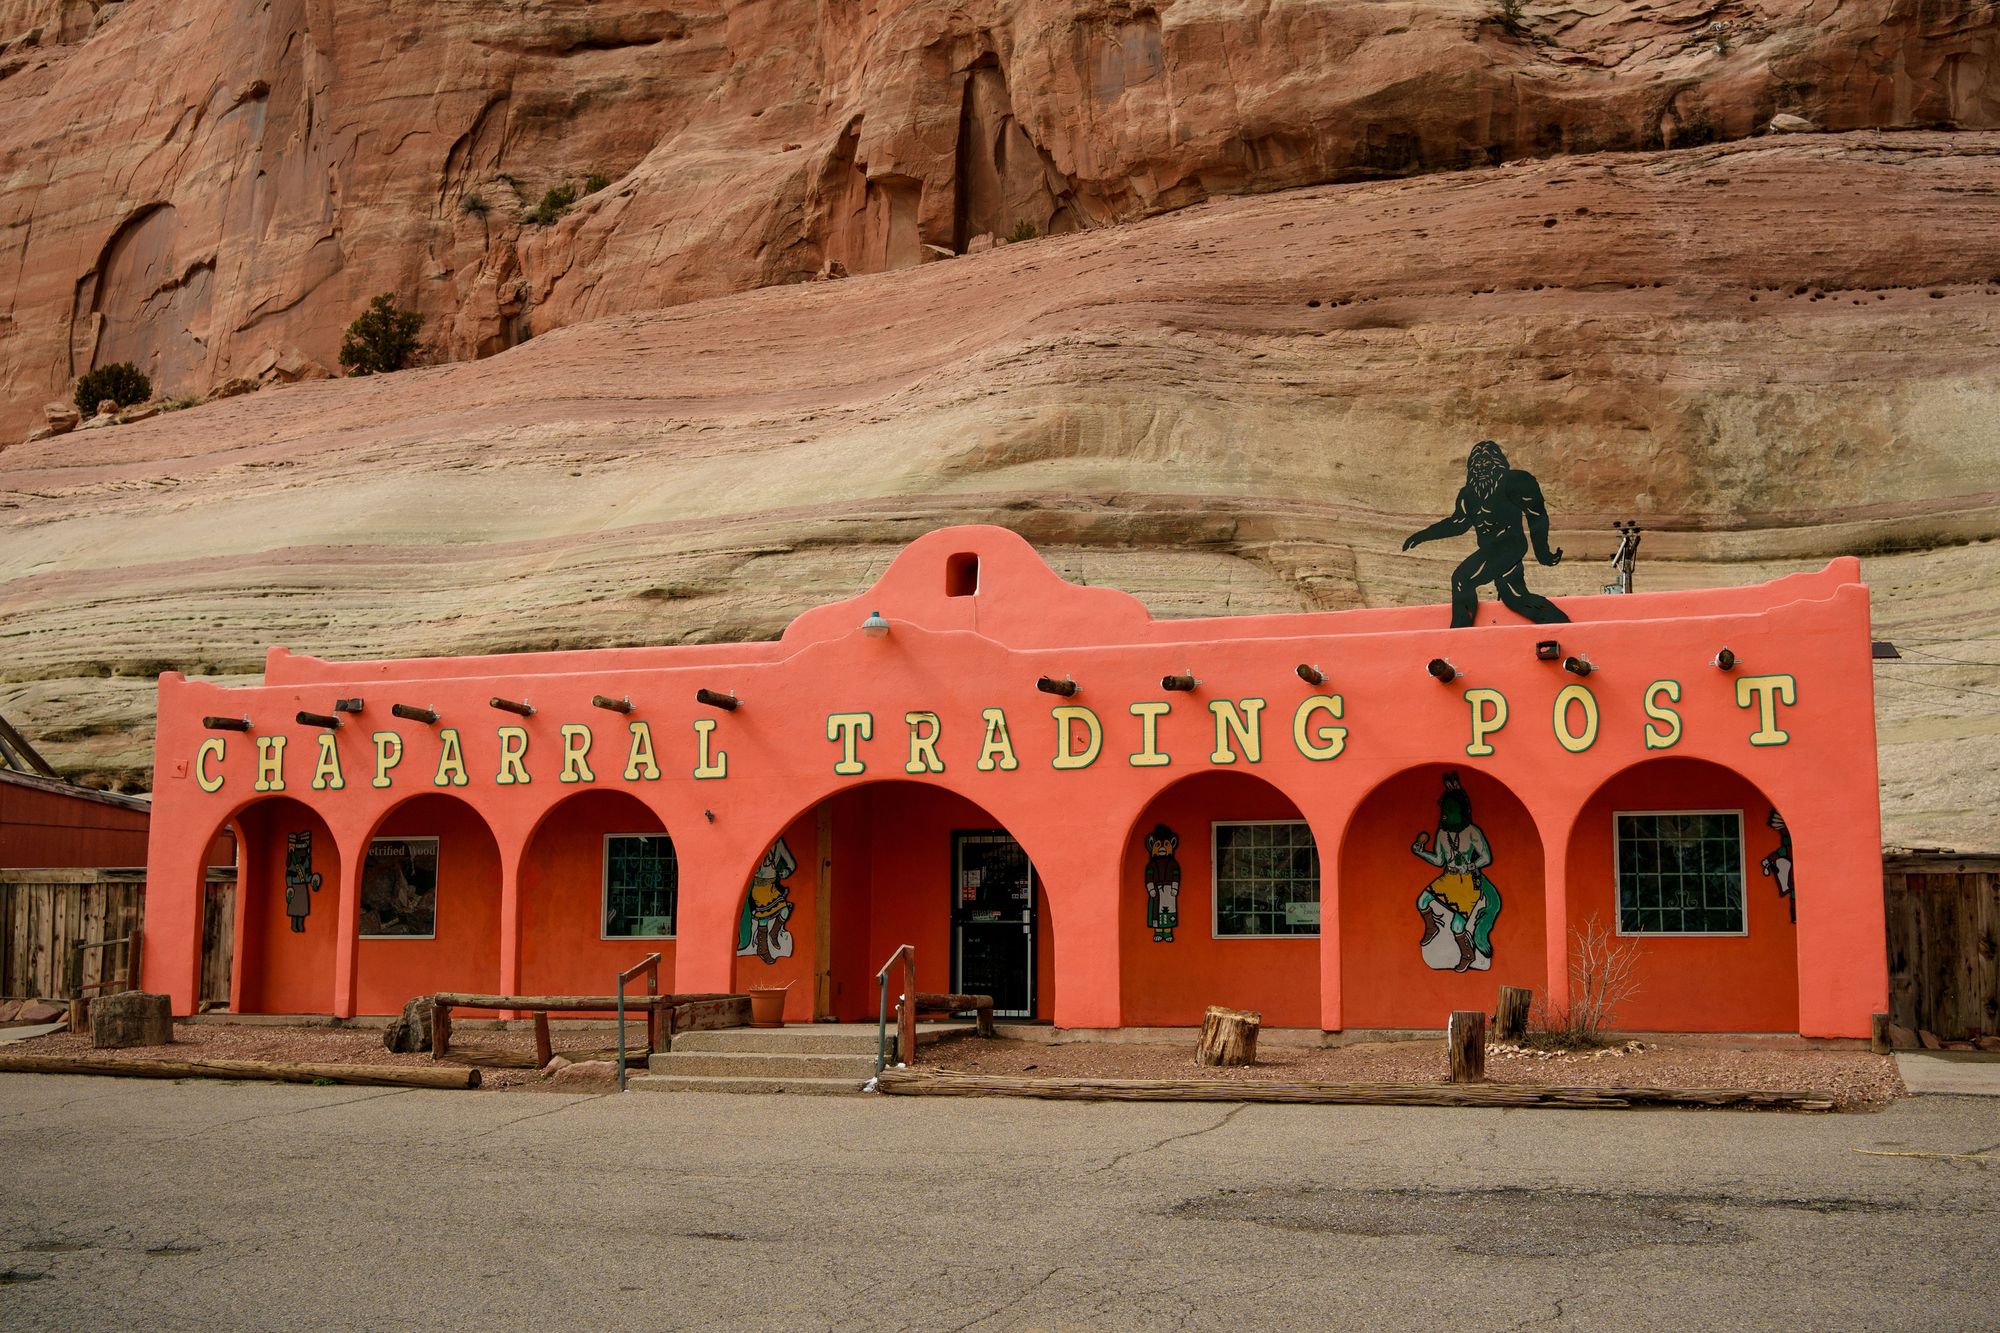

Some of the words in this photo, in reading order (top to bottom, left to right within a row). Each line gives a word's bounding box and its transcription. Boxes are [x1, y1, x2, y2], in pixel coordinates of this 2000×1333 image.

[195, 718, 728, 793] CHAPARRAL
[826, 694, 1349, 776] TRADING
[1463, 674, 1797, 757] POST
[368, 844, 405, 857] etrified
[408, 844, 436, 857] Wood
